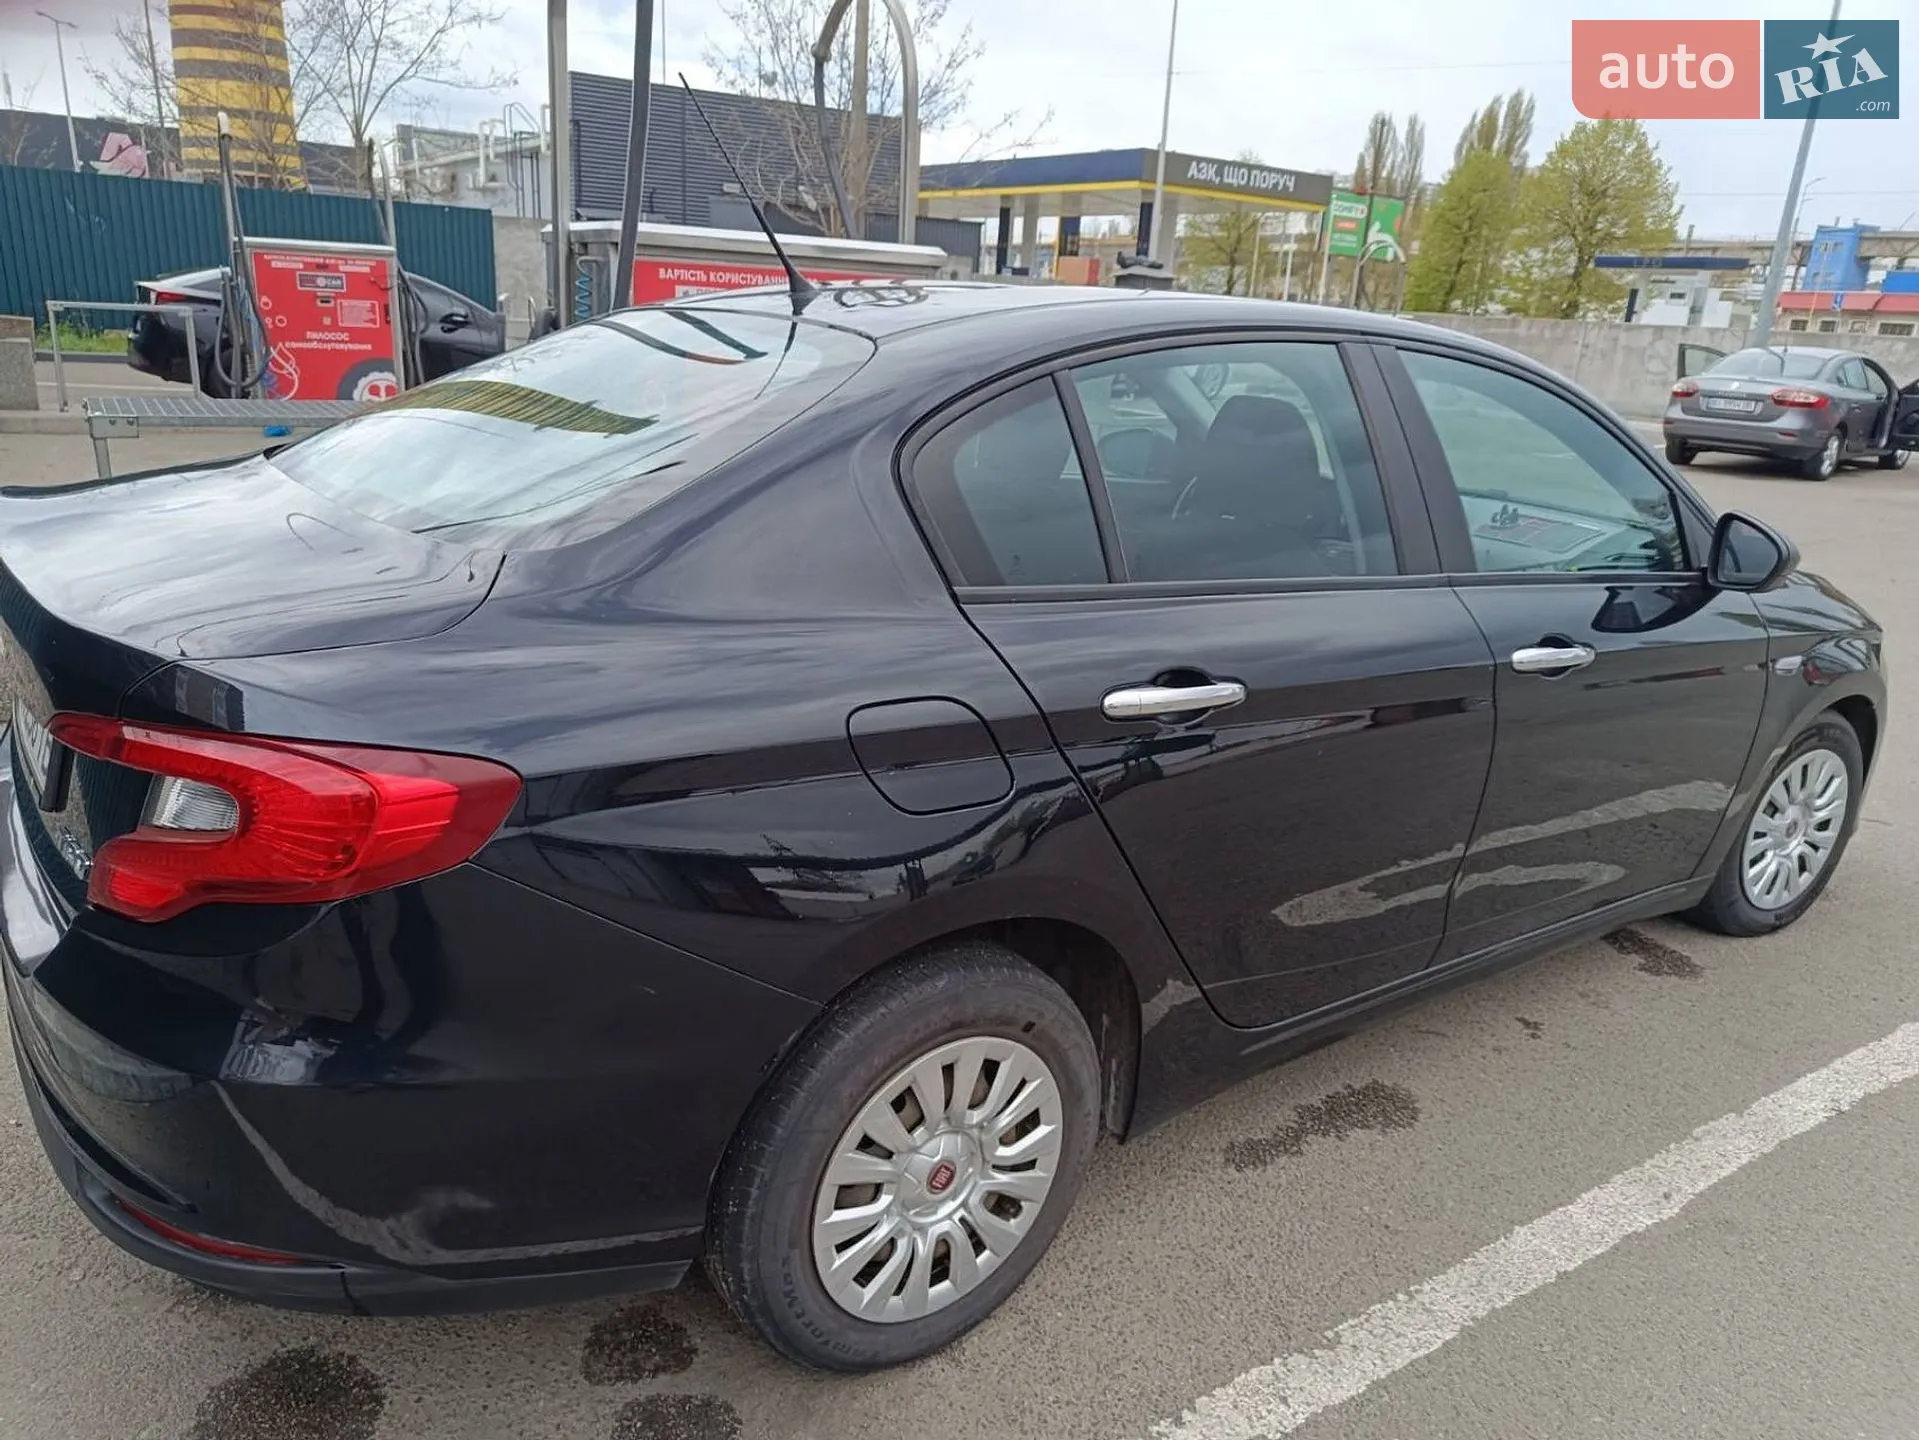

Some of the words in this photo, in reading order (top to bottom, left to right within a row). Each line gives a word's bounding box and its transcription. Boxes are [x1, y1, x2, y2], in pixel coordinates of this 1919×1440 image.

[1188, 160, 1221, 184] АЗК,
[1223, 165, 1249, 187] ЩО
[1251, 170, 1296, 192] ПОРУЧ
[658, 267, 708, 282] ВАРТІСТЬ
[306, 331, 349, 341] ПИЛОСОС
